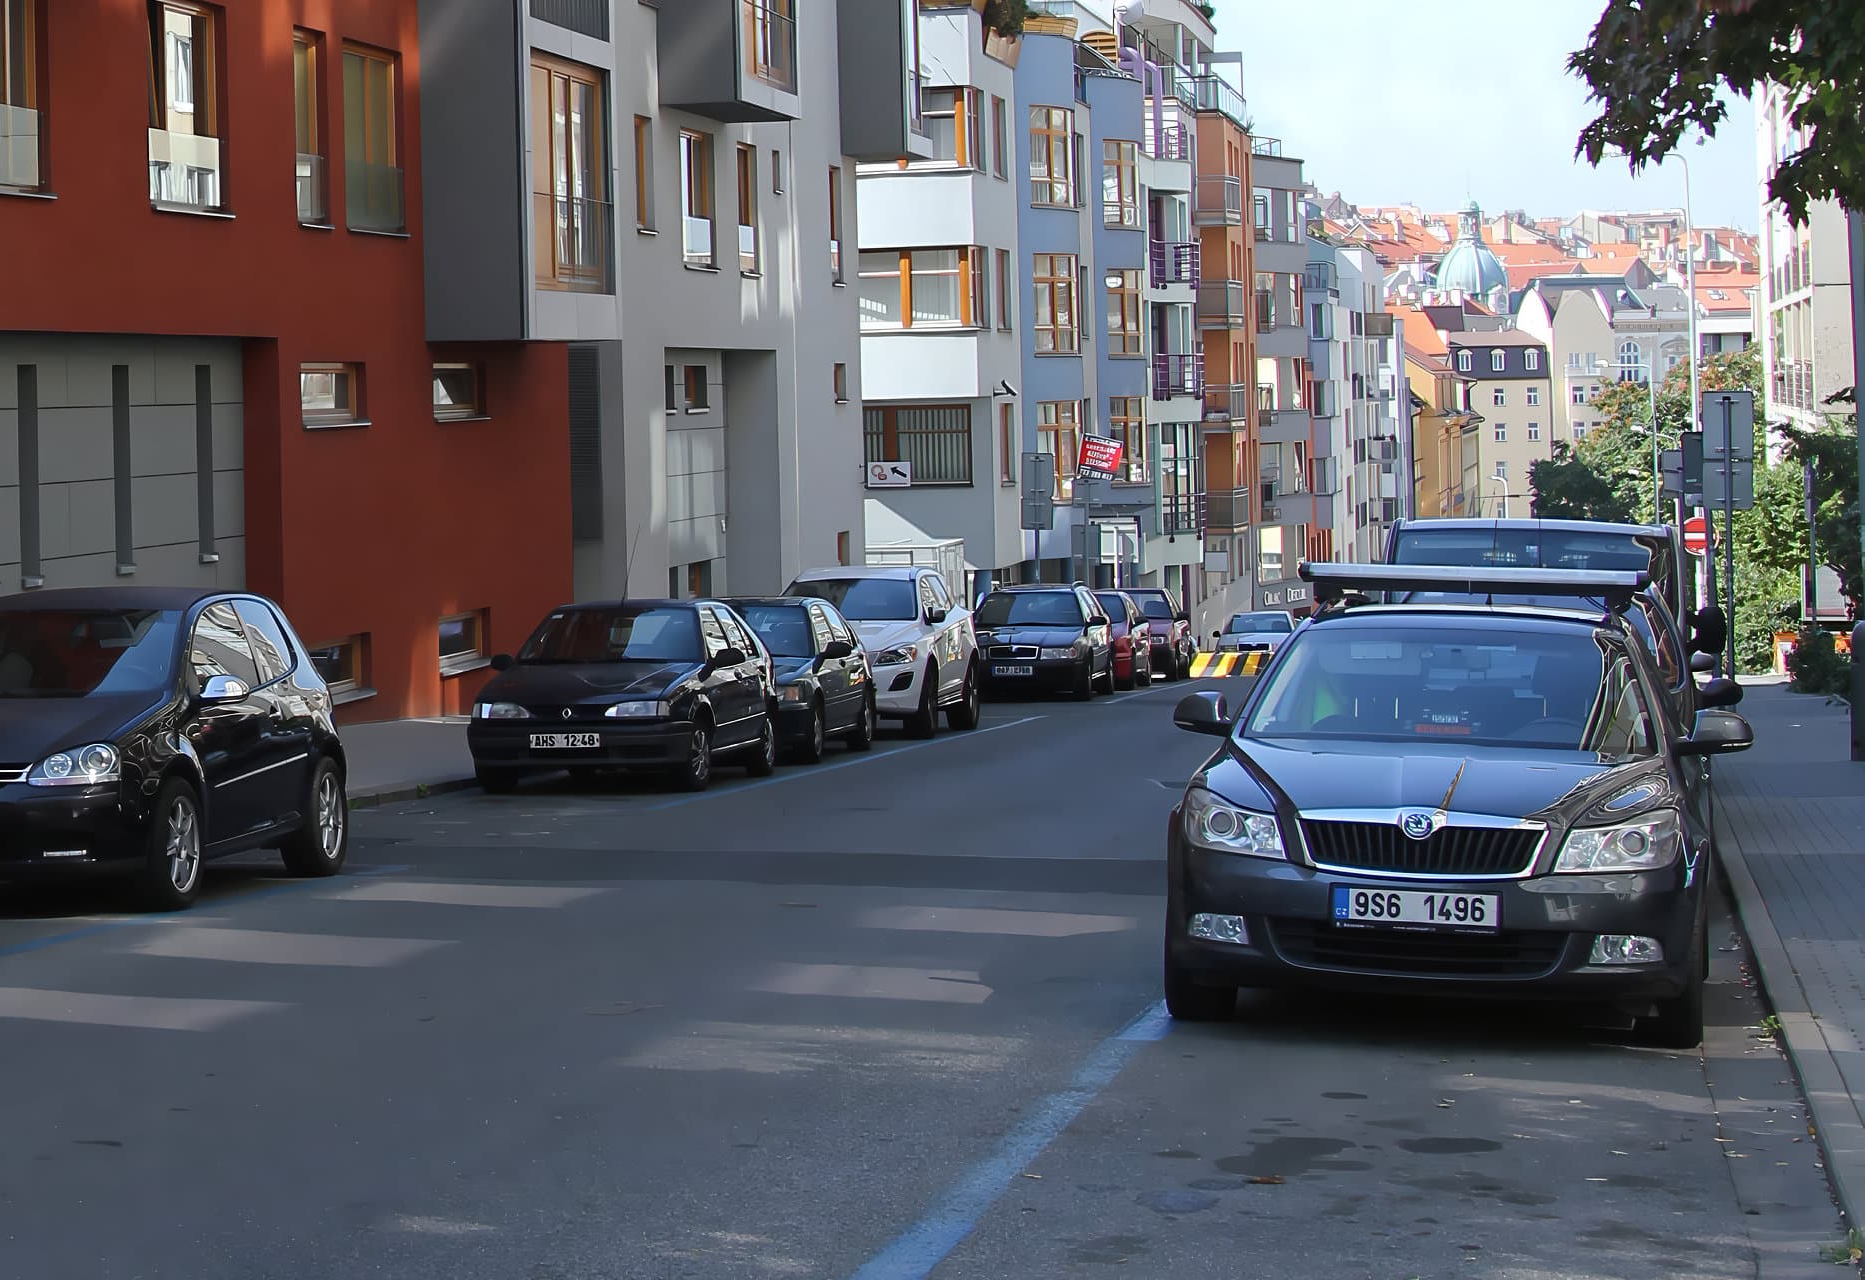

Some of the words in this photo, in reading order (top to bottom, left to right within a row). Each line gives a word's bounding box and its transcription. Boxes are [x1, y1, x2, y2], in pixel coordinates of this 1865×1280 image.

[535, 736, 555, 747] AHS
[1336, 908, 1348, 916] CZ
[1355, 892, 1401, 918] 9S6
[1423, 895, 1485, 922] 1496
